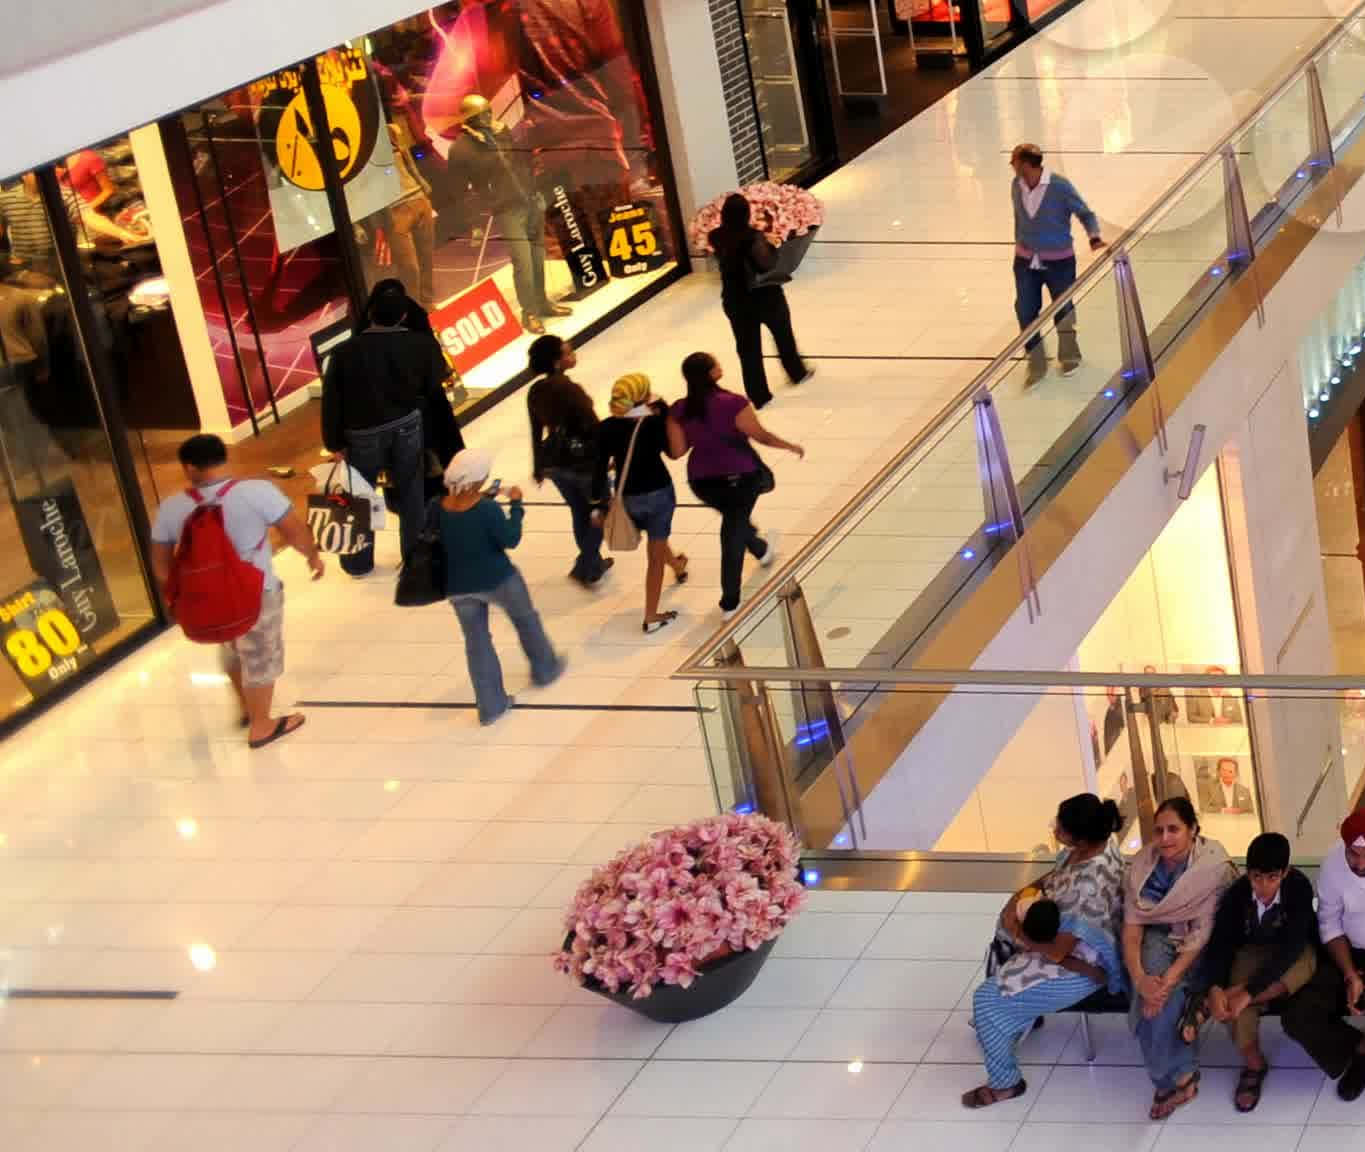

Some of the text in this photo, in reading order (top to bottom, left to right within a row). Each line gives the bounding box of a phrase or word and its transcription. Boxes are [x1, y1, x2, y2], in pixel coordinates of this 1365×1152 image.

[553, 185, 598, 288] Guy Laroche
[609, 221, 657, 261] 45
[441, 300, 506, 356] SOLD
[40, 498, 82, 590] Laroche
[6, 608, 81, 678] 80
[48, 656, 78, 681] Only
